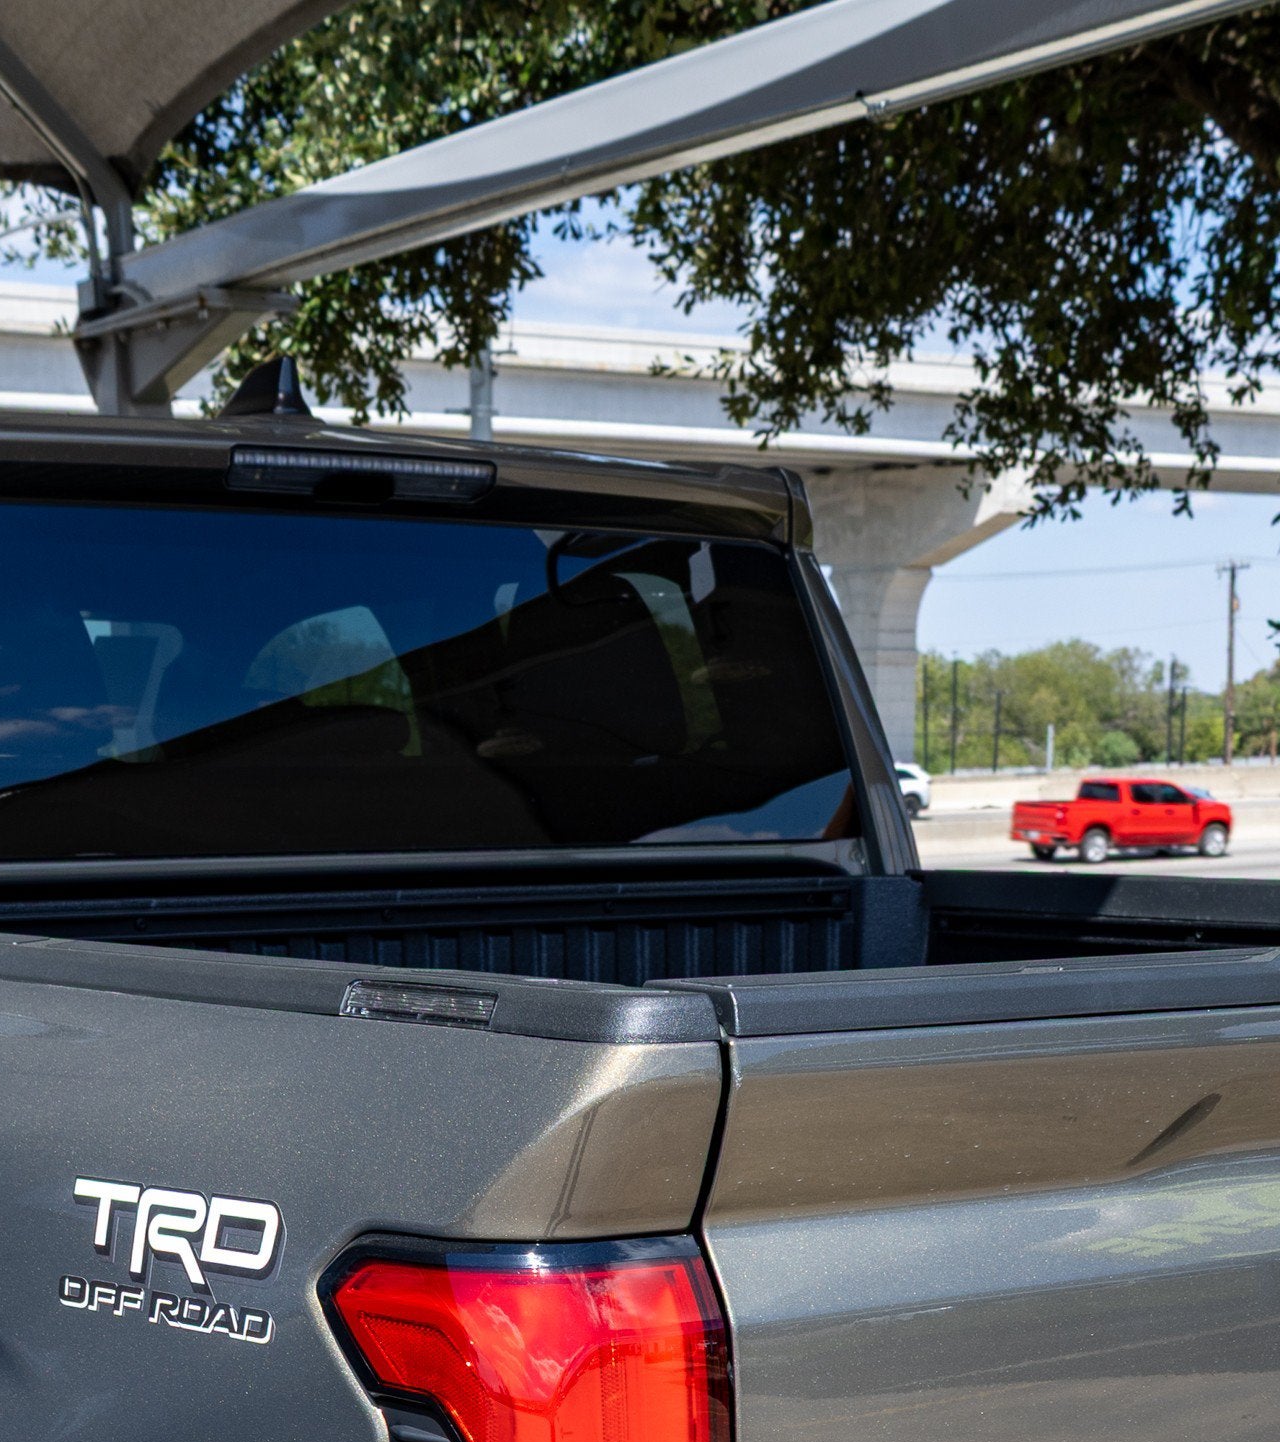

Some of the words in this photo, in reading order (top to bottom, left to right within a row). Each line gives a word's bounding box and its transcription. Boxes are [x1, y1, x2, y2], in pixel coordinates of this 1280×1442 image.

[72, 1175, 287, 1296] TRD
[58, 1274, 145, 1317] OFF
[148, 1290, 277, 1345] ROAD
